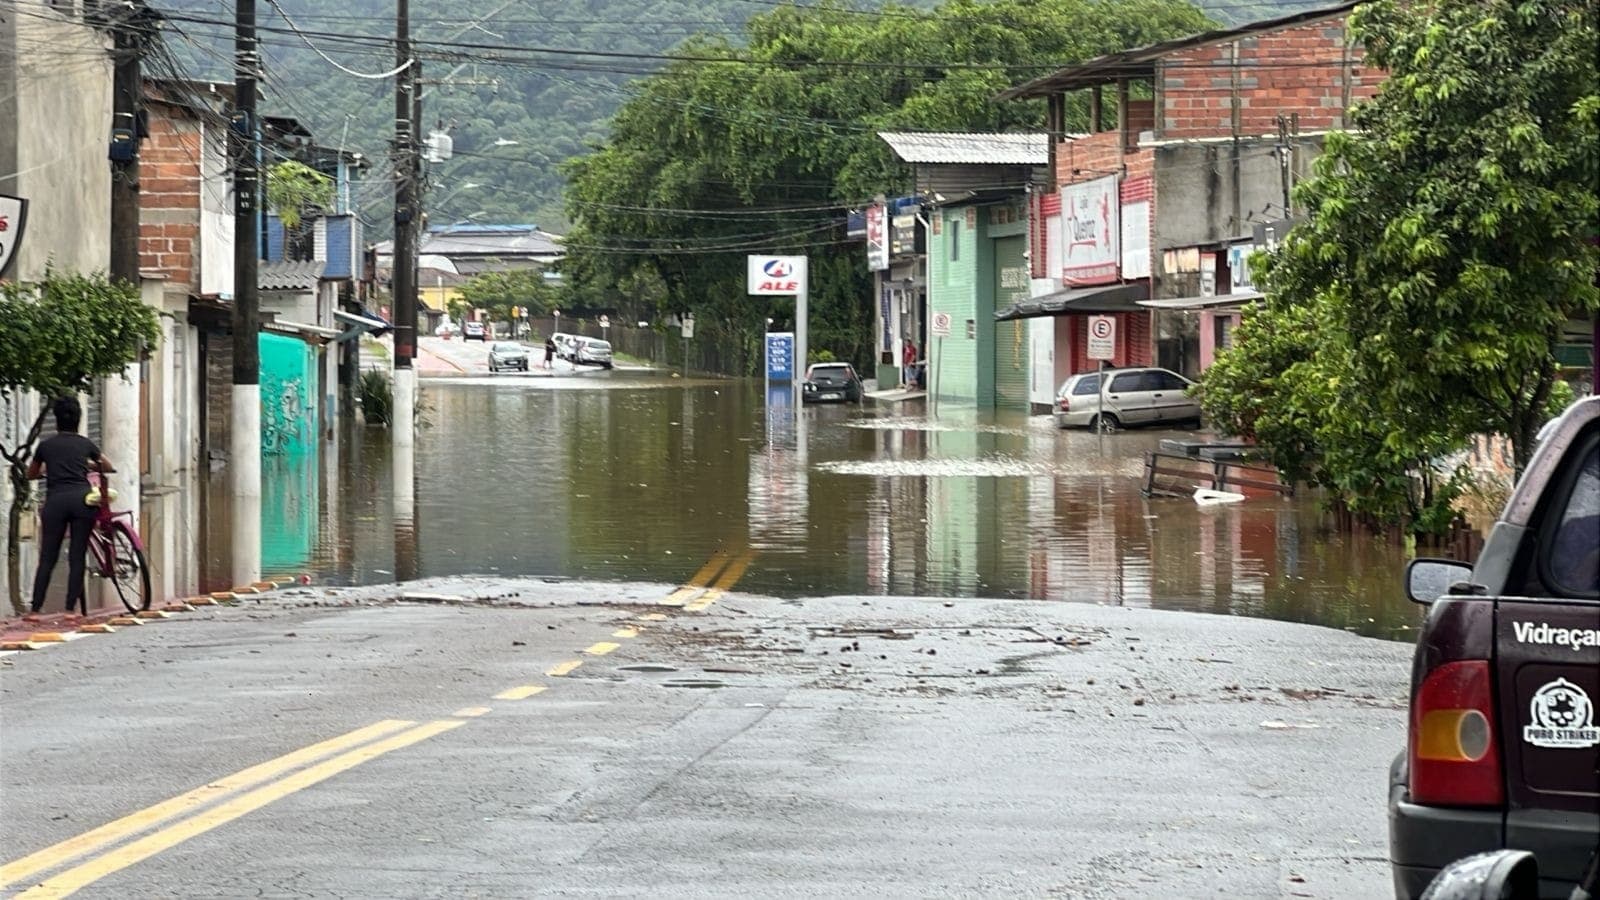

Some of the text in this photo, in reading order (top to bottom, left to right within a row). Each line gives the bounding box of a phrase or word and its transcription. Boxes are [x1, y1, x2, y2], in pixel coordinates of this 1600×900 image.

[758, 282, 799, 291] ALE
[1098, 323, 1106, 335] E
[1528, 729, 1598, 741] PURO STRIKER
